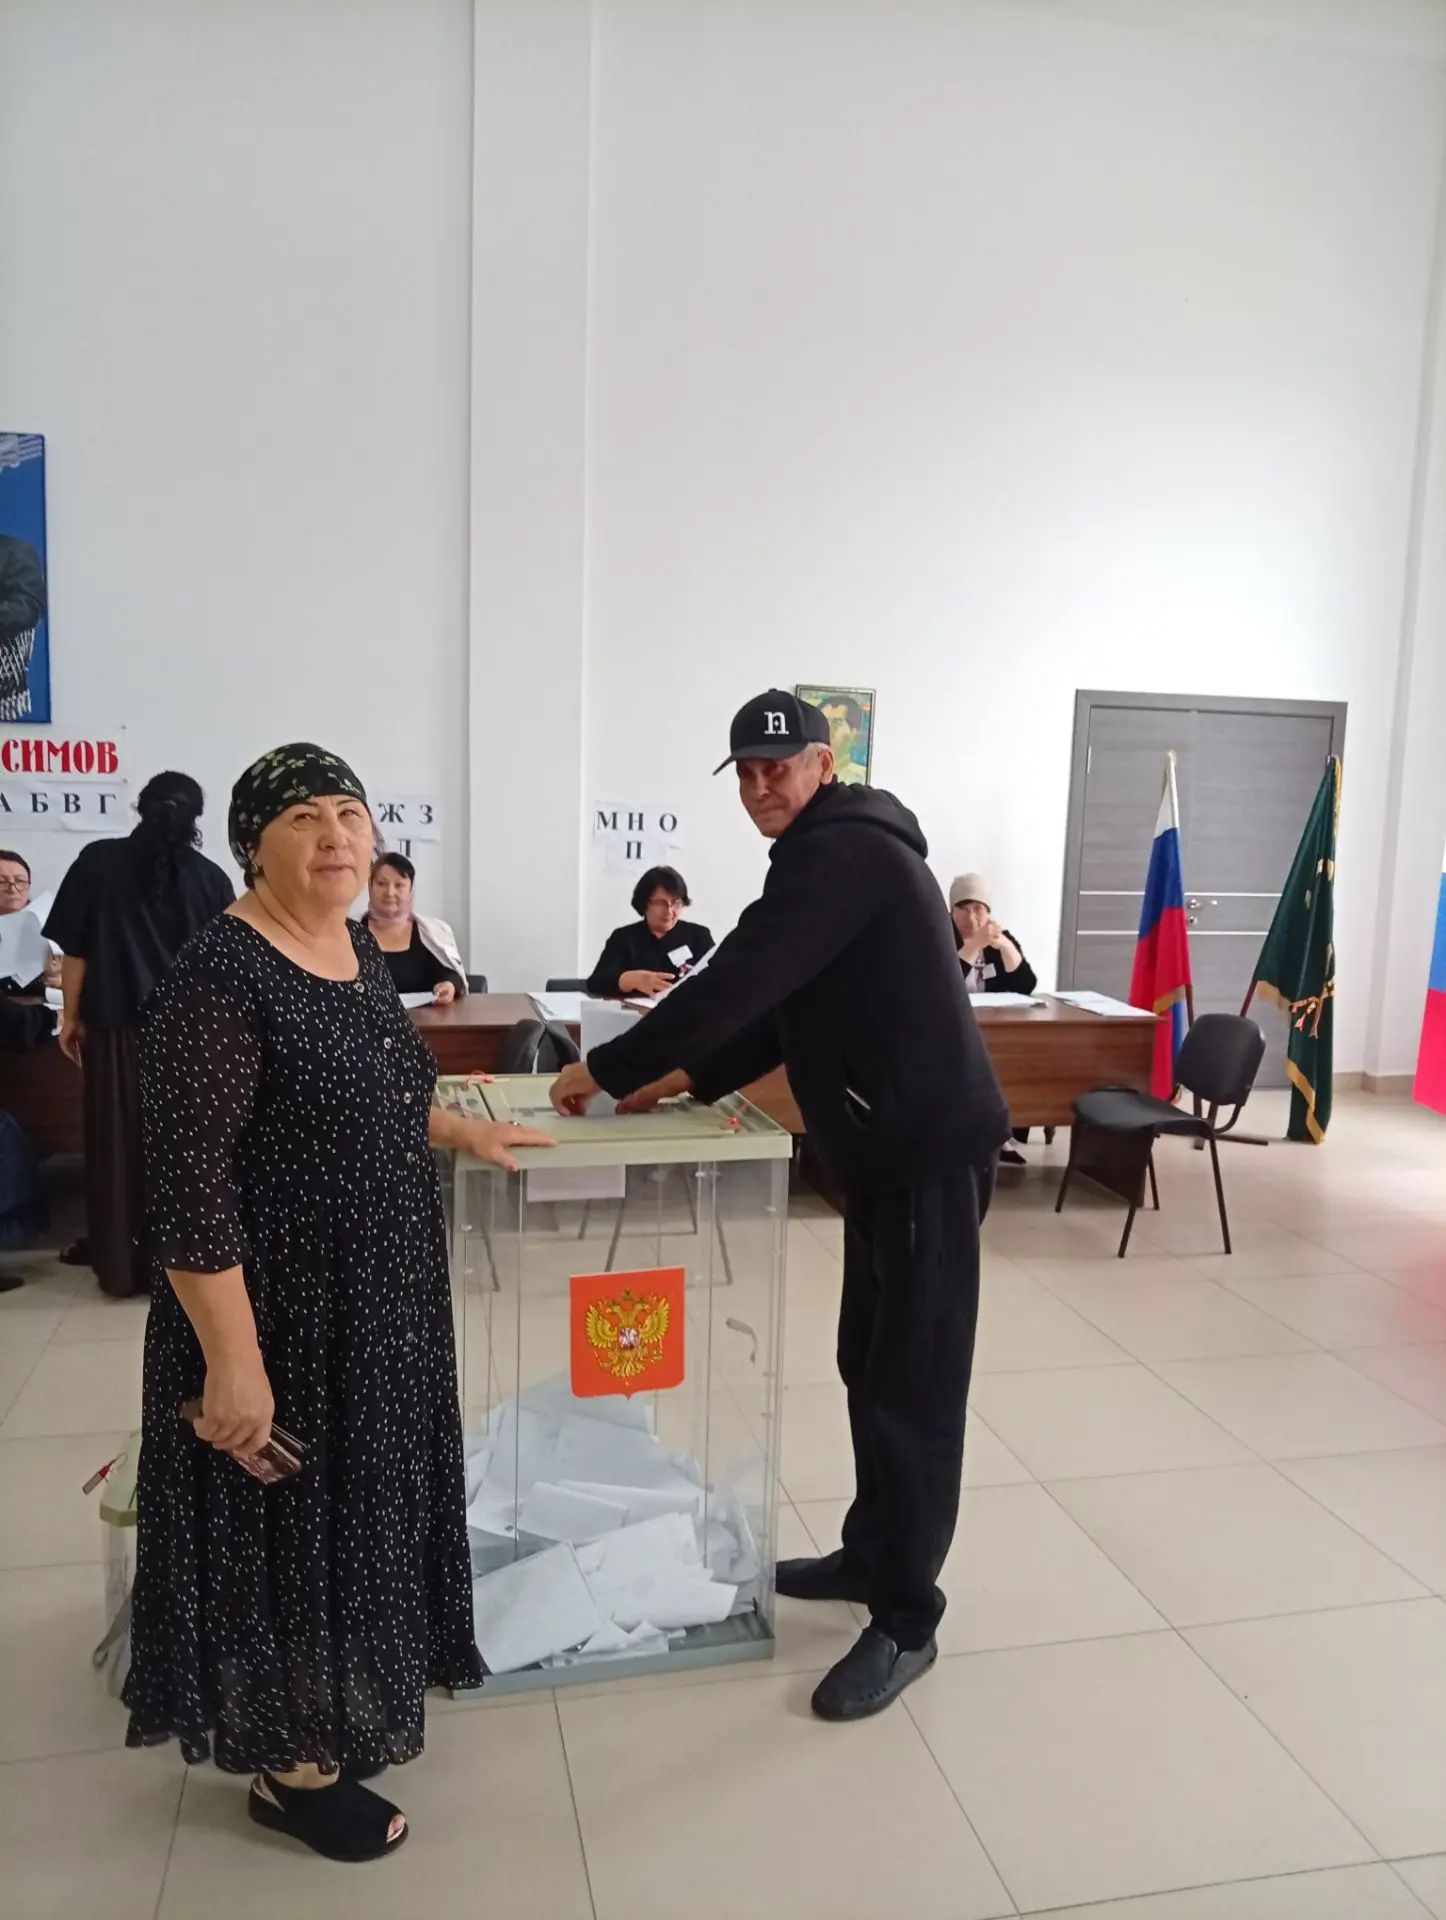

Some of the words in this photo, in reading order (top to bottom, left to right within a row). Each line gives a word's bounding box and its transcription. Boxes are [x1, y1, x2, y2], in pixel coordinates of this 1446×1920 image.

[764, 711, 789, 735] n
[30, 792, 49, 813] Б
[64, 793, 81, 814] В
[98, 793, 116, 814] Г
[378, 802, 405, 824] Ж
[419, 804, 433, 825] З
[597, 810, 617, 831] М
[627, 811, 645, 831] Н
[659, 812, 677, 832] О
[625, 840, 643, 860] П
